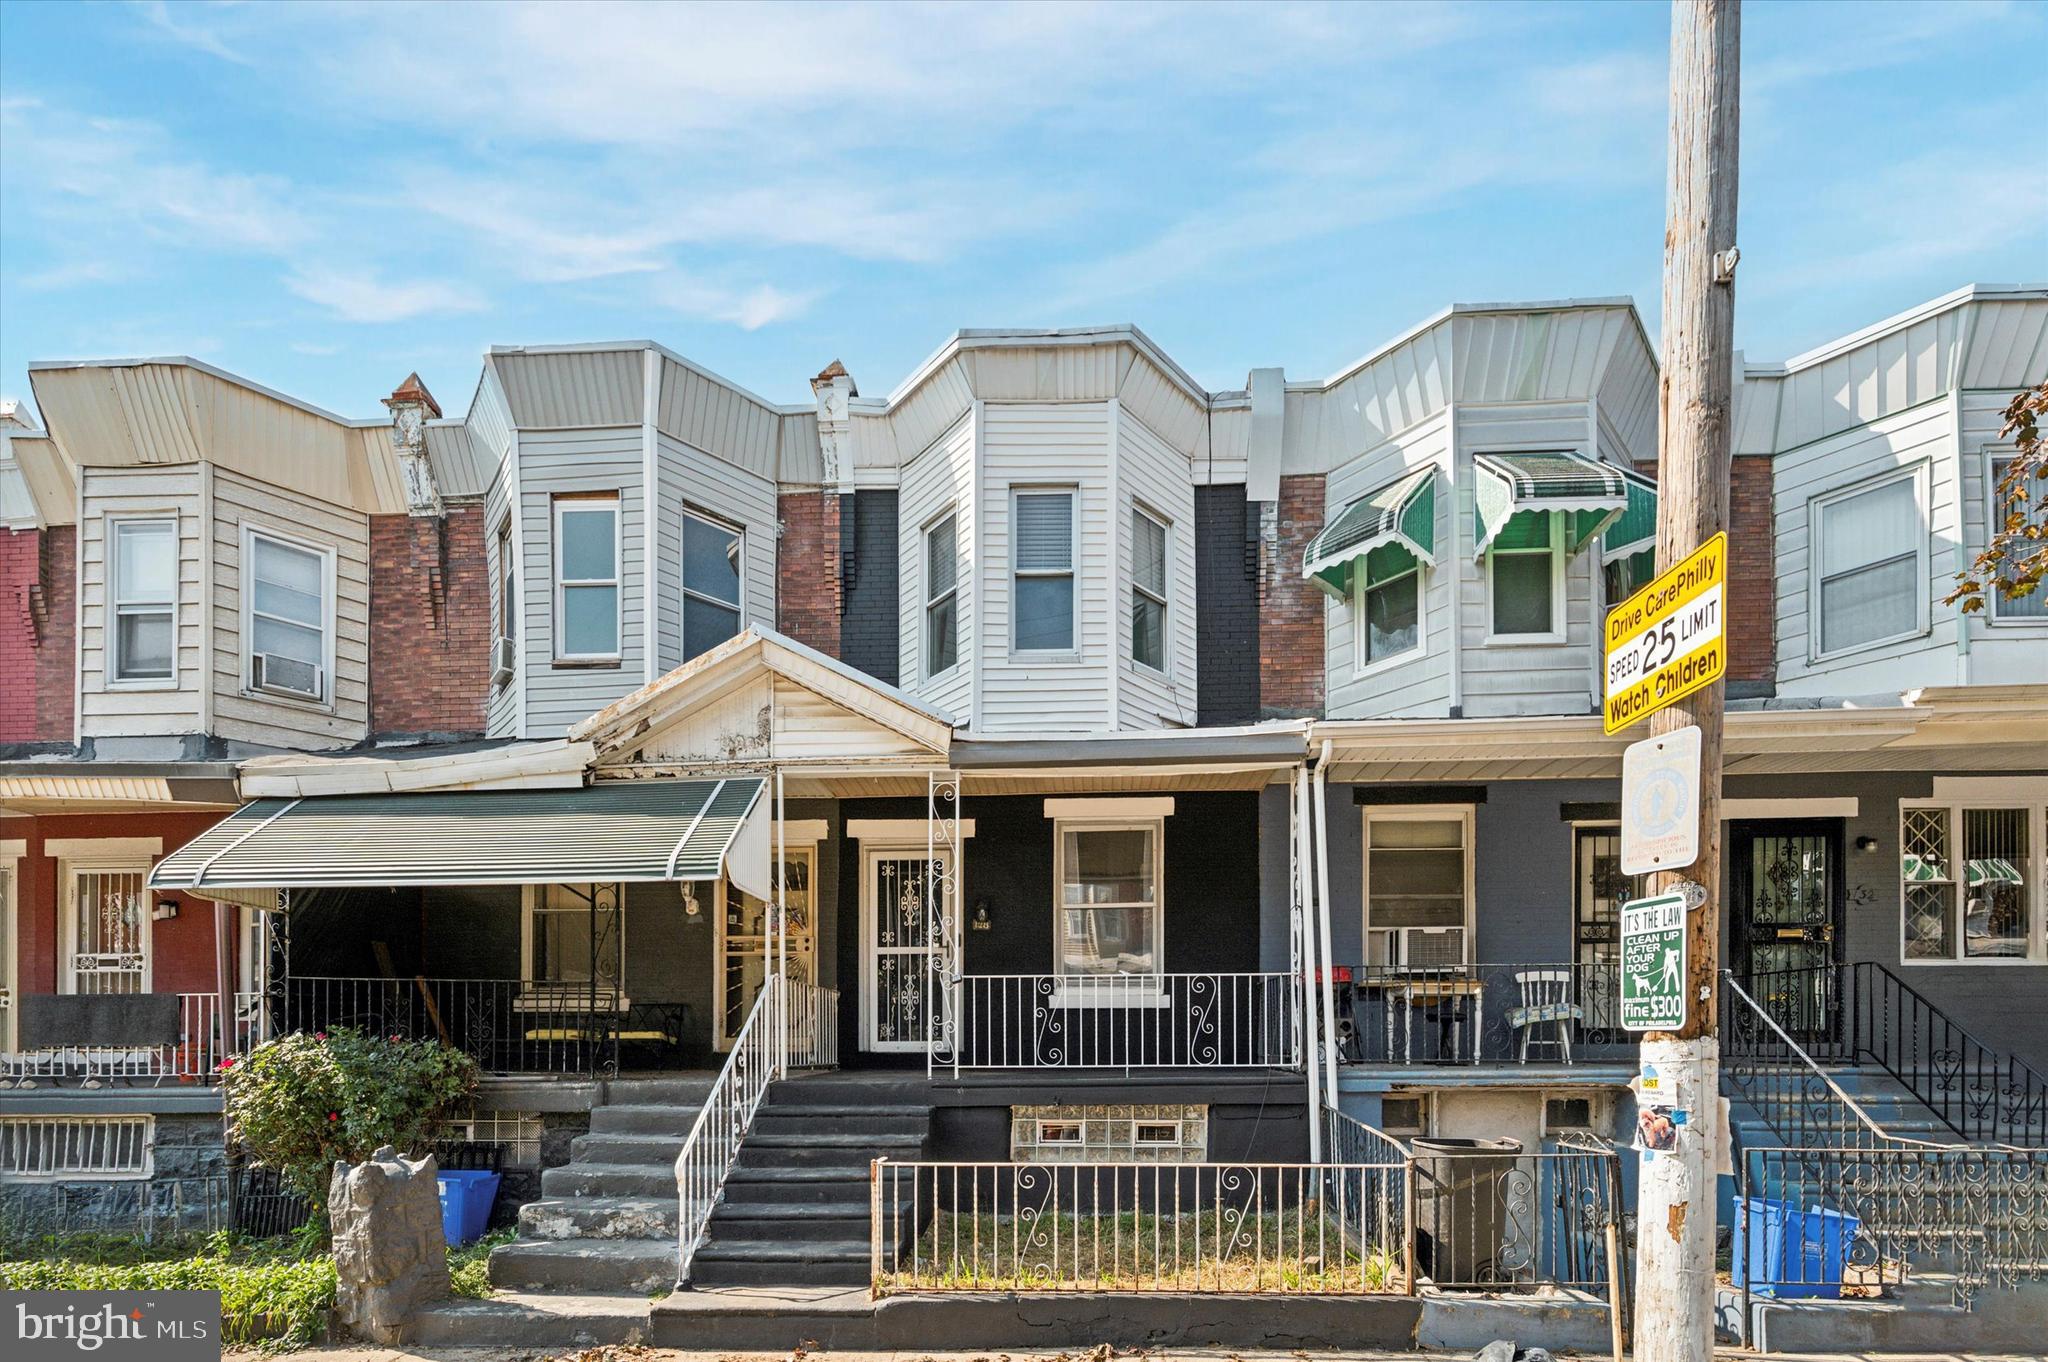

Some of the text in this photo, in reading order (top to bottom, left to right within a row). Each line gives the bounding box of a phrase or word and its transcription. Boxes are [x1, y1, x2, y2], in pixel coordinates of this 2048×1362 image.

[1612, 555, 1717, 641] Drive CarePhilly
[1610, 599, 1717, 684] SPEED 25 LIMIT
[1610, 649, 1717, 723] Watch Children
[1624, 906, 1682, 933] IT'S THE LAW
[1626, 930, 1680, 946] CLEAN UP
[1626, 942, 1661, 956] AFTER
[1626, 953, 1655, 964] YOUR
[1626, 963, 1649, 973] DOG
[1624, 994, 1682, 1018] fine $300
